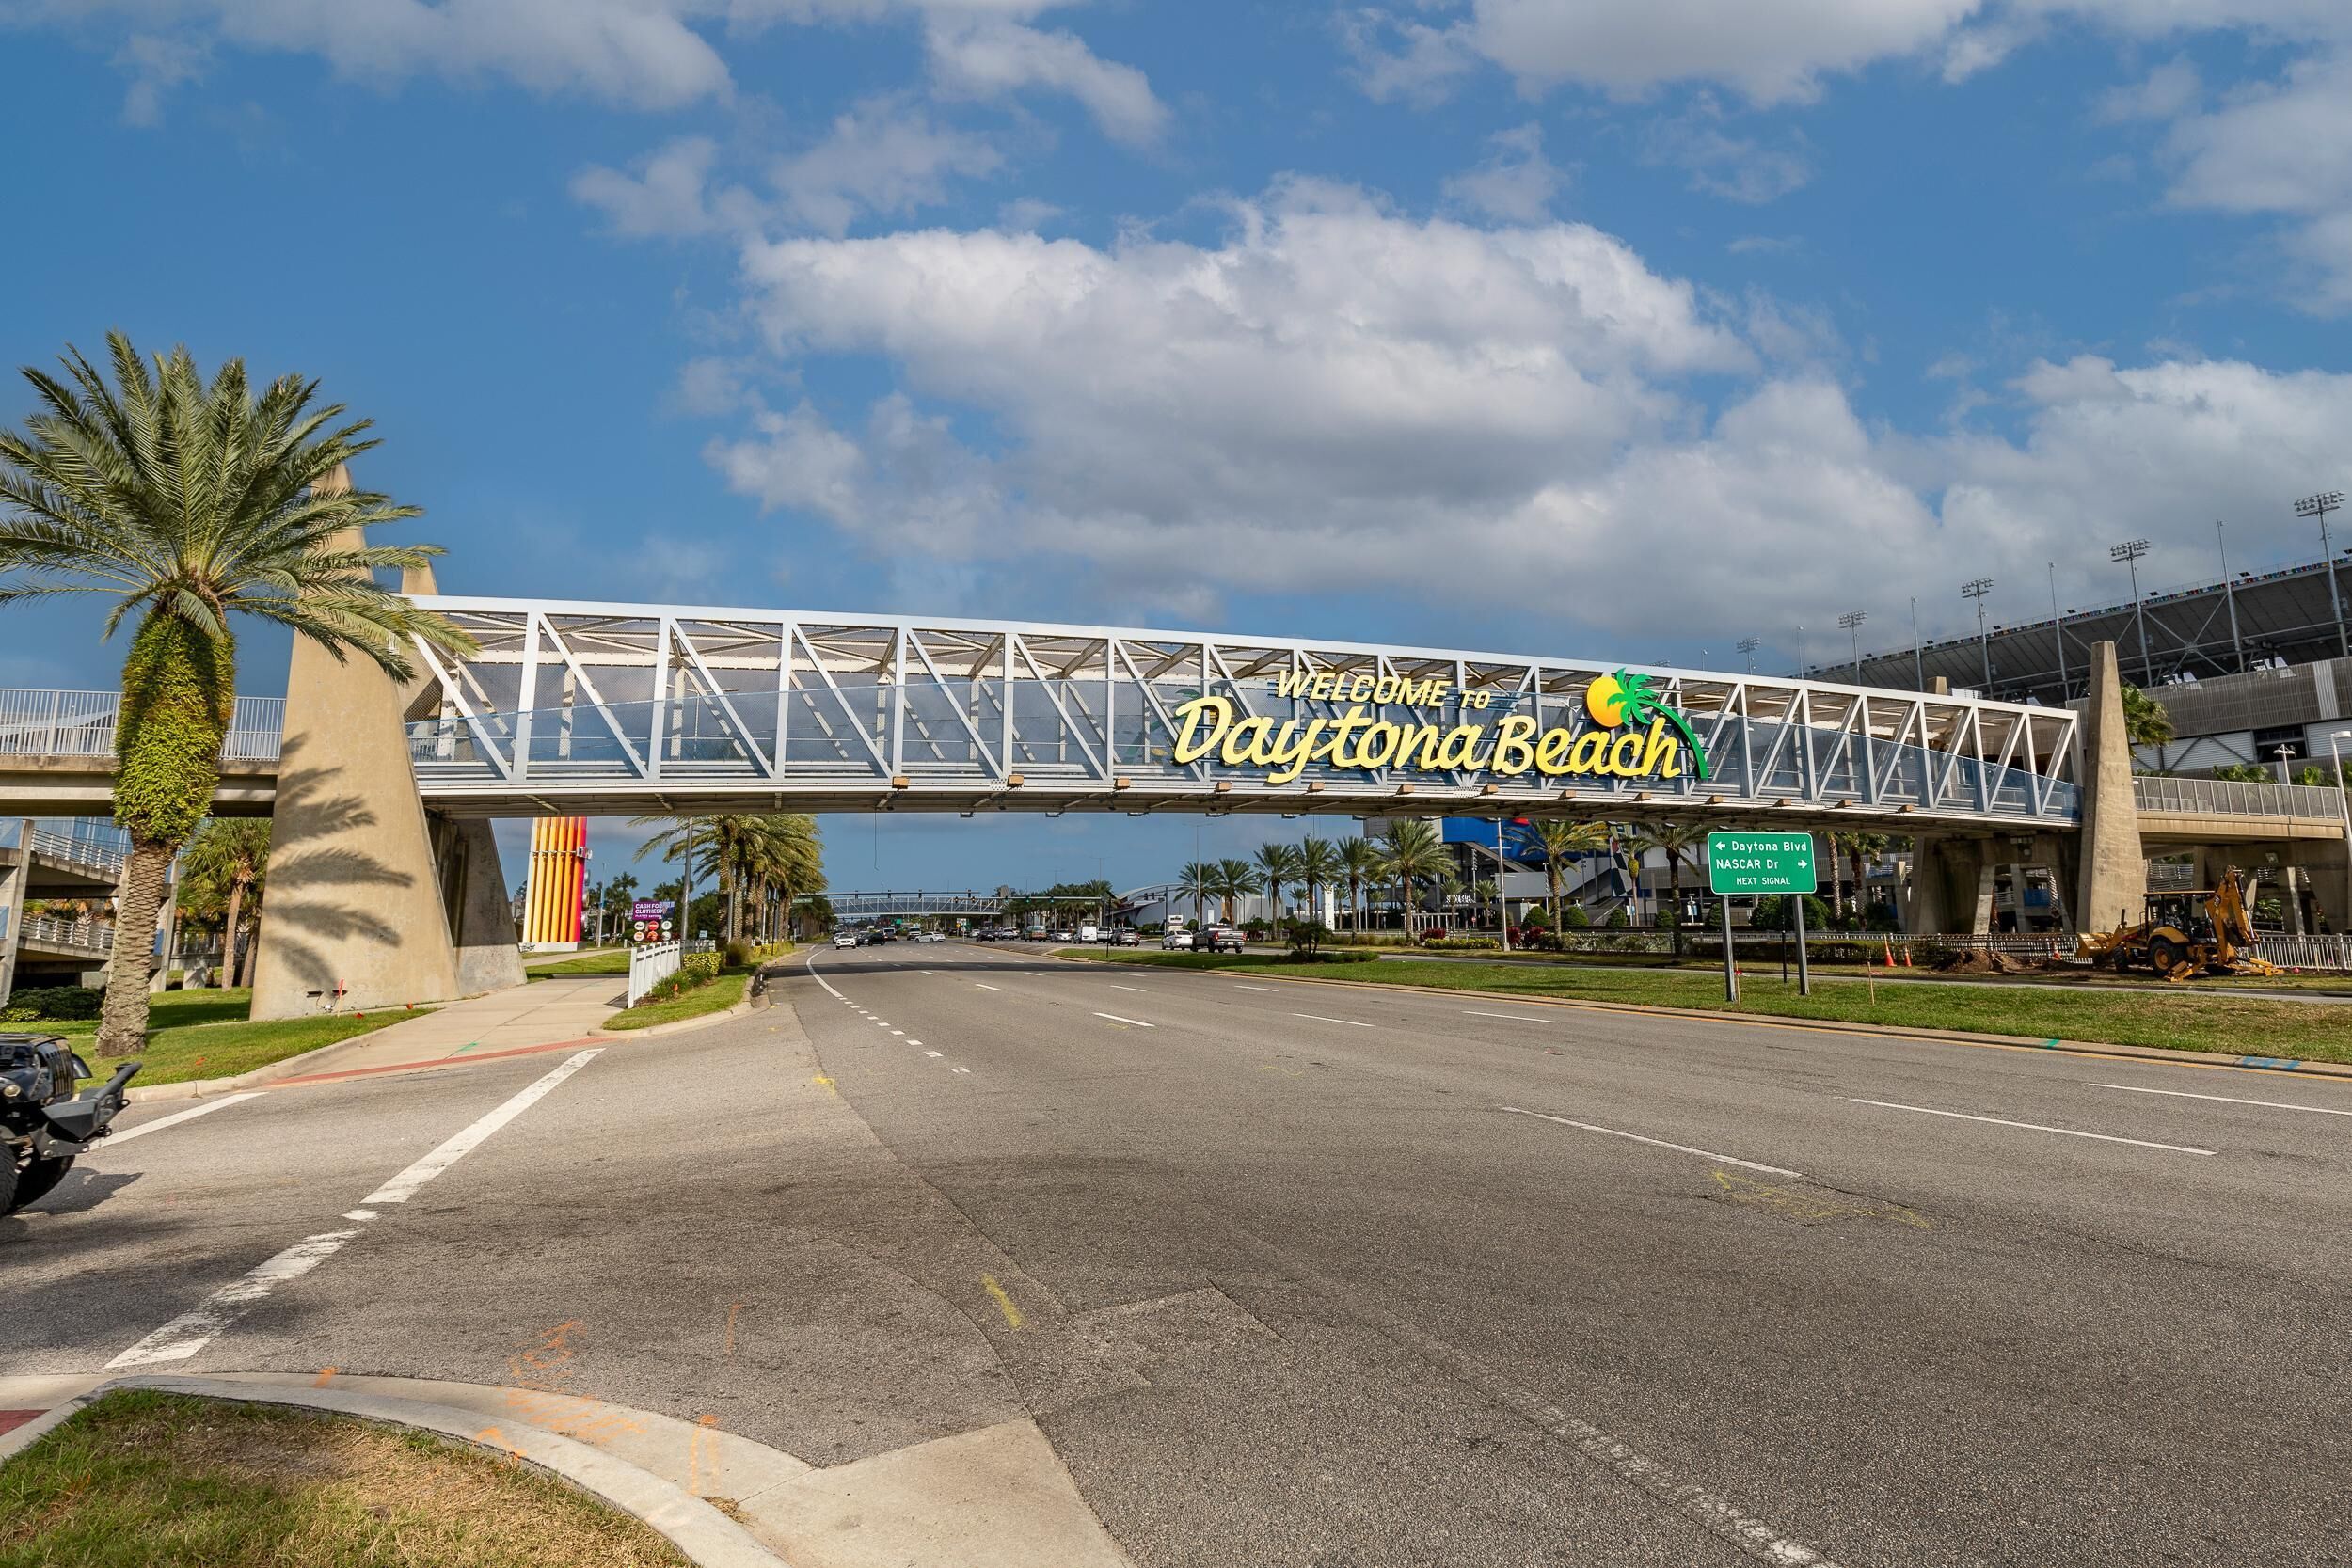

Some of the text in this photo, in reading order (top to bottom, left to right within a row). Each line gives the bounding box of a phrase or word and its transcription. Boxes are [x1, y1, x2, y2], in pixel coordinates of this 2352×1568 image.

[1277, 669, 1491, 709] WELCOME TO
[1175, 696, 1682, 784] Daytona Beach
[1731, 840, 1807, 853] Daytona Blvd
[1715, 859, 1779, 870] NASCAR Dr
[1736, 877, 1791, 885] NEXT SIGNAL
